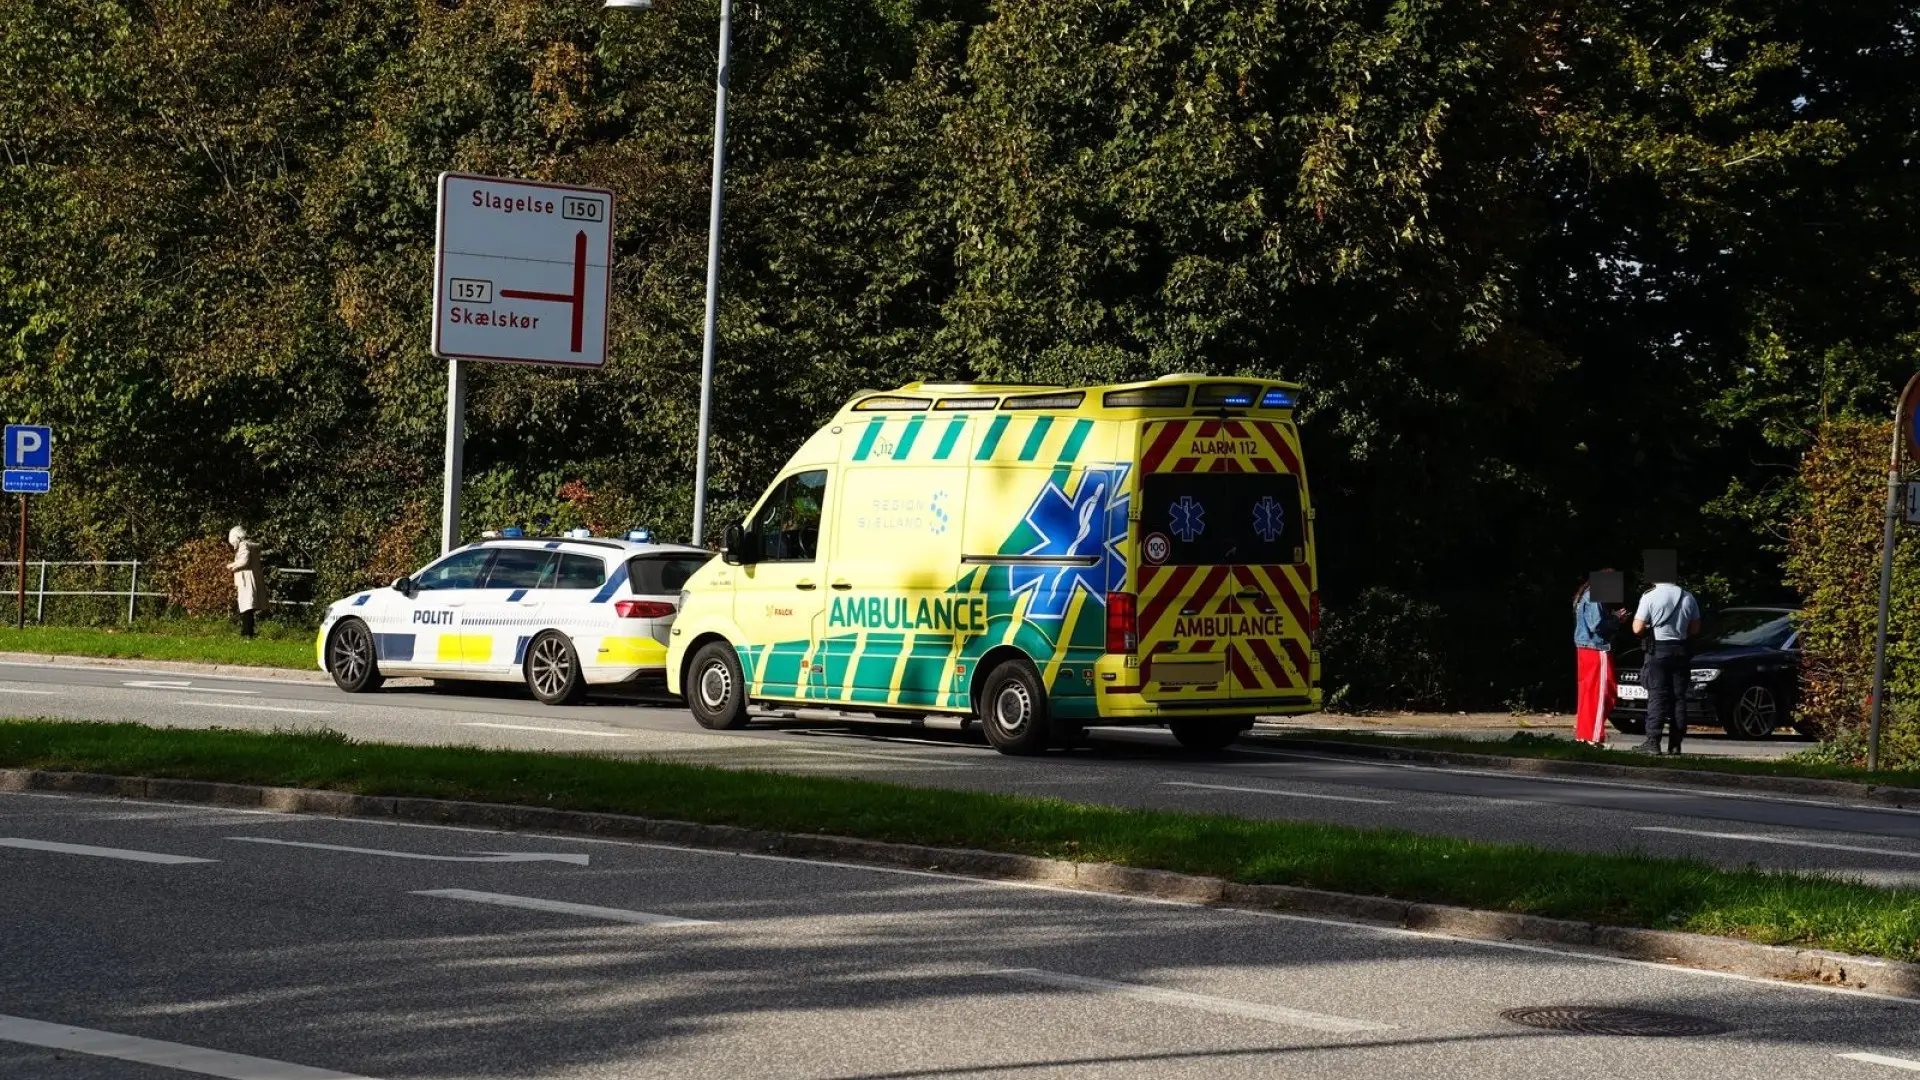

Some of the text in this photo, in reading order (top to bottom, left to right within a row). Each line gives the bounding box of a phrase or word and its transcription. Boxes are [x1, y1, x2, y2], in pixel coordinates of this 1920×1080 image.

[472, 190, 596, 217] Slagelse 150
[458, 284, 484, 298] 157
[450, 307, 539, 328] Skælskør
[16, 430, 42, 463] P
[880, 443, 894, 454] 112
[1191, 440, 1258, 454] ALARM 112
[1150, 542, 1164, 552] 100
[413, 610, 454, 624] POLITI
[774, 608, 792, 616] FALCK
[828, 596, 985, 630] AMBULANCE
[1173, 616, 1284, 638] AMBULANCE
